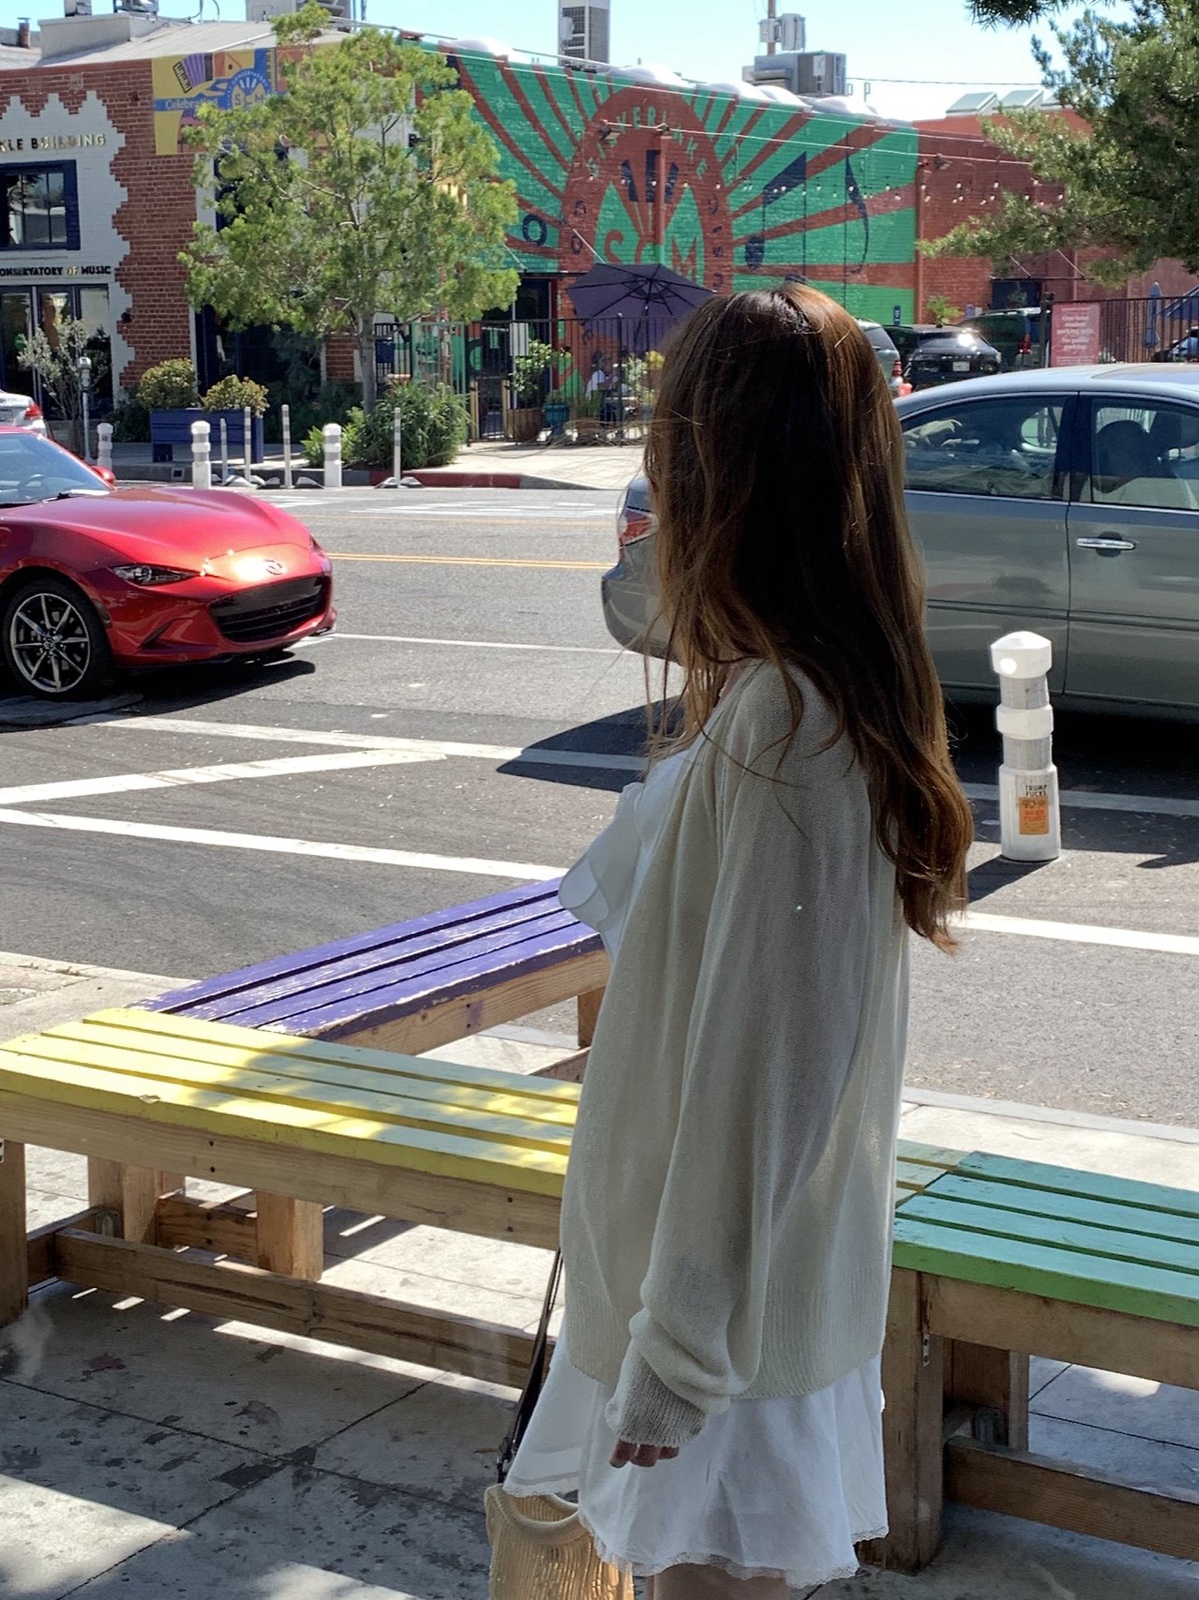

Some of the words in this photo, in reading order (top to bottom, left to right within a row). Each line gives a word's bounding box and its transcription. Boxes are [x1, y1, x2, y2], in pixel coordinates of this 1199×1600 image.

[31, 133, 106, 150] BUILDING
[66, 266, 78, 276] OF
[81, 265, 111, 275] MUSIC
